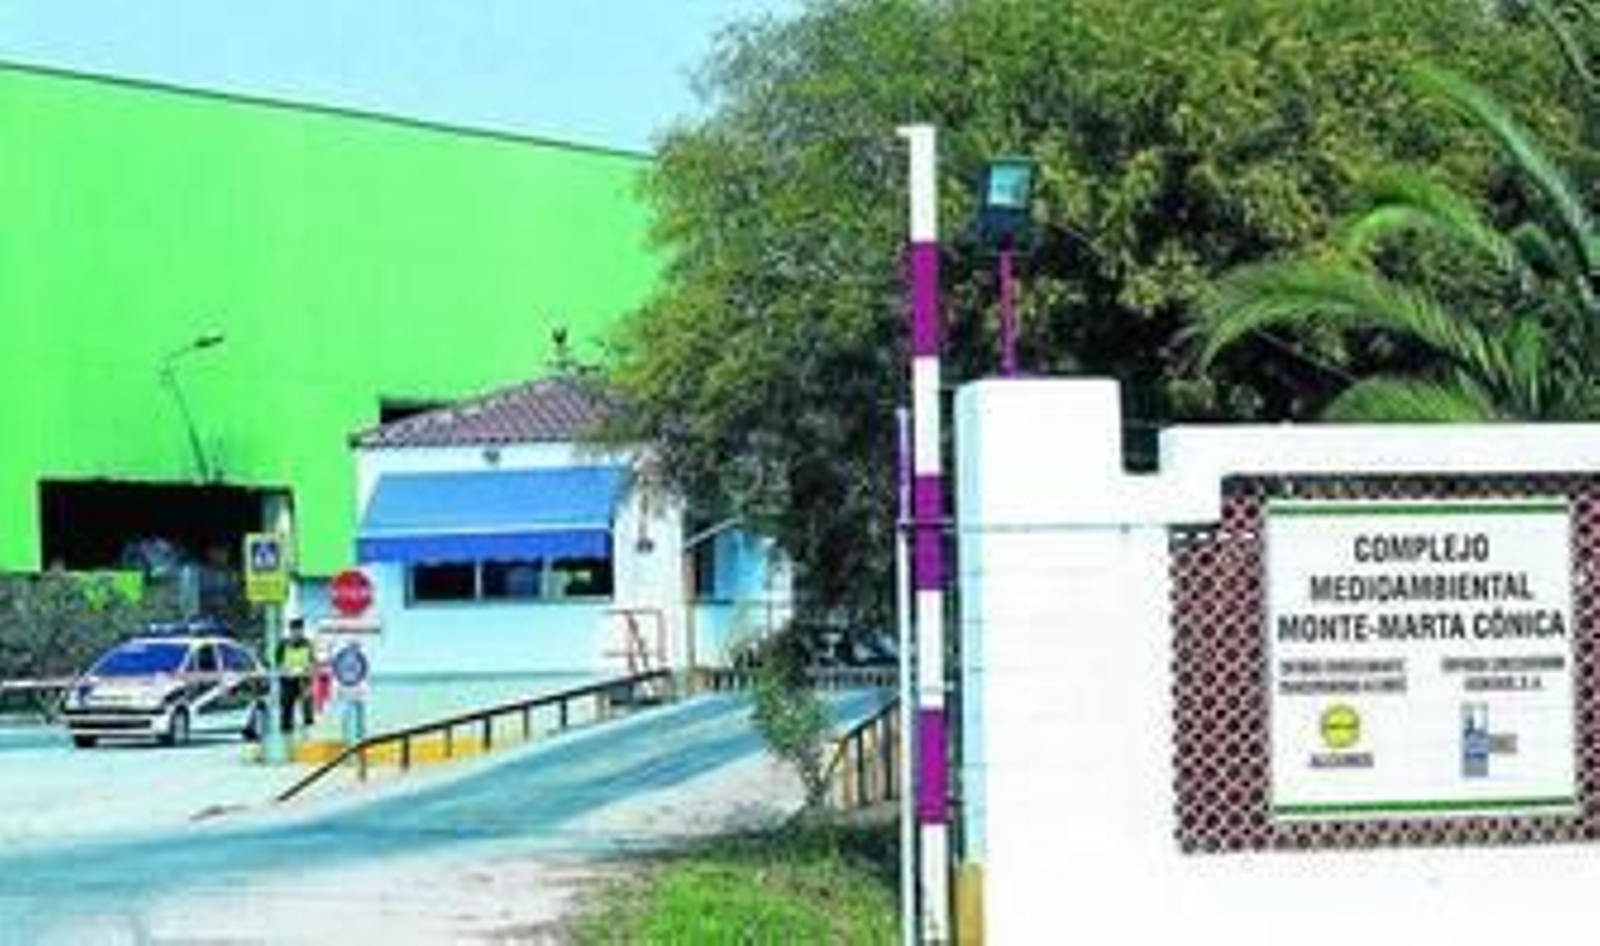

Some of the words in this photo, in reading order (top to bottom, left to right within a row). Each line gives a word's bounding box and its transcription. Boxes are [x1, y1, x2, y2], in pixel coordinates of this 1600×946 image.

[1354, 534, 1489, 562] COMPLEJO
[1309, 574, 1534, 601] MEDIOAMBIENTAL
[1277, 612, 1466, 643] MONTE-MARTA
